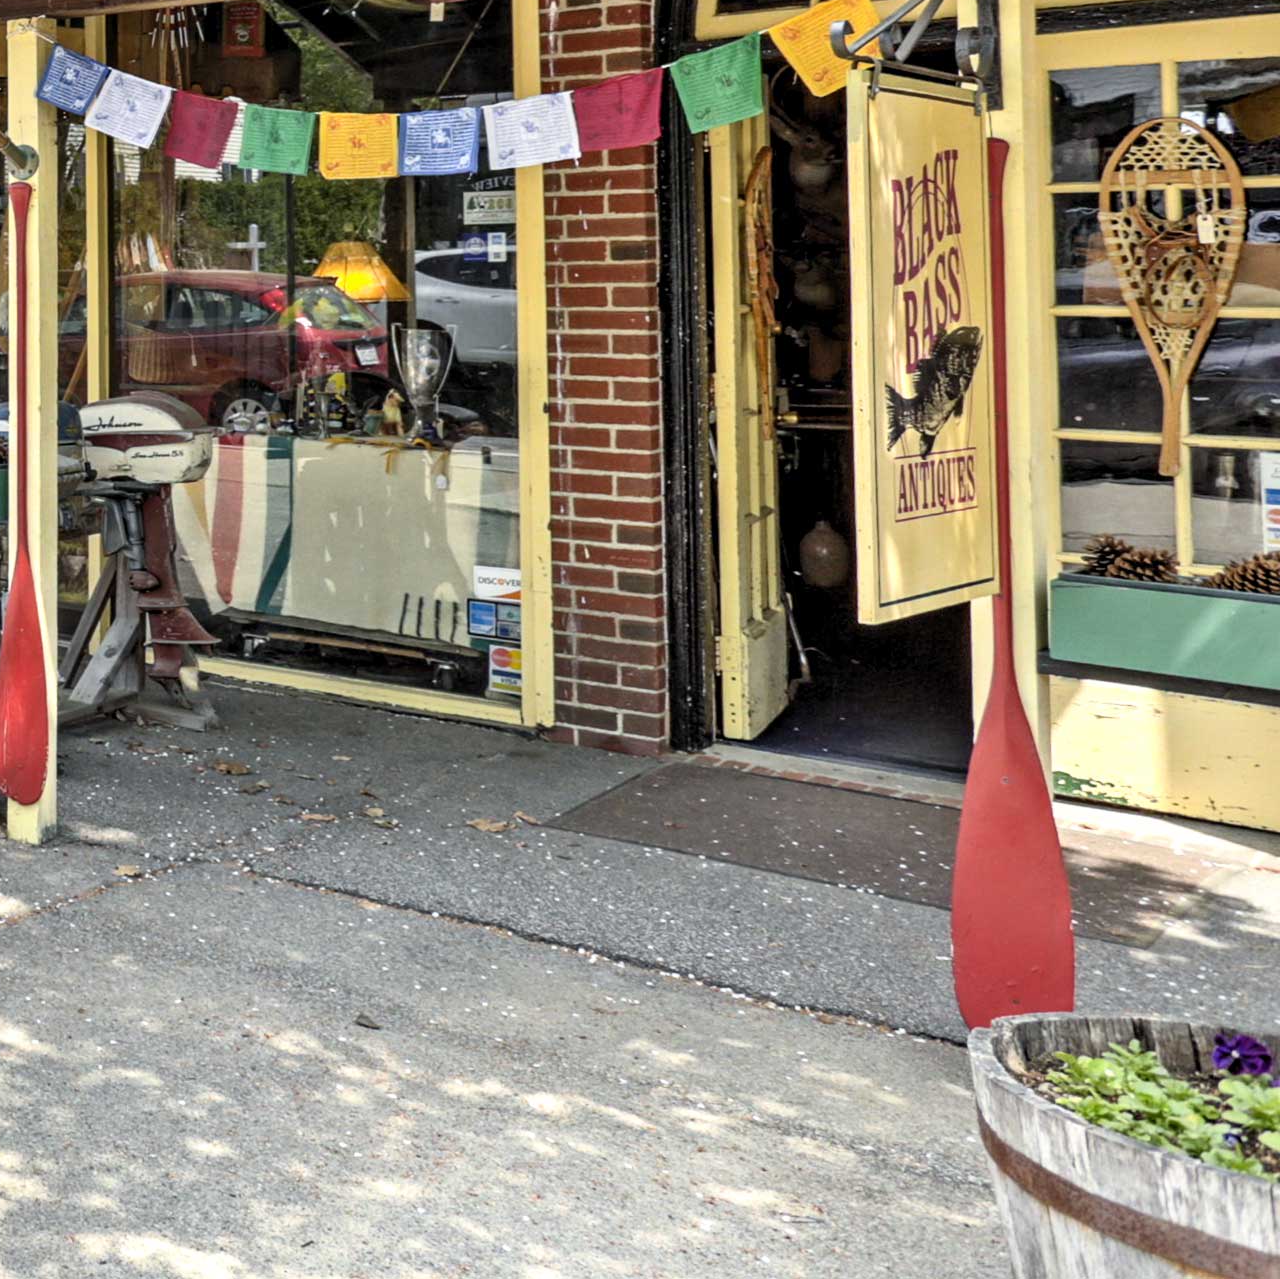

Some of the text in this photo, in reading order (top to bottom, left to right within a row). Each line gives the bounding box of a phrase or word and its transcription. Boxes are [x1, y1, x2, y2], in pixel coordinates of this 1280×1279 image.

[891, 149, 961, 286] BLACK
[903, 247, 962, 375] BASS
[82, 416, 143, 431] Johnson
[898, 455, 977, 514] ANTIQUES
